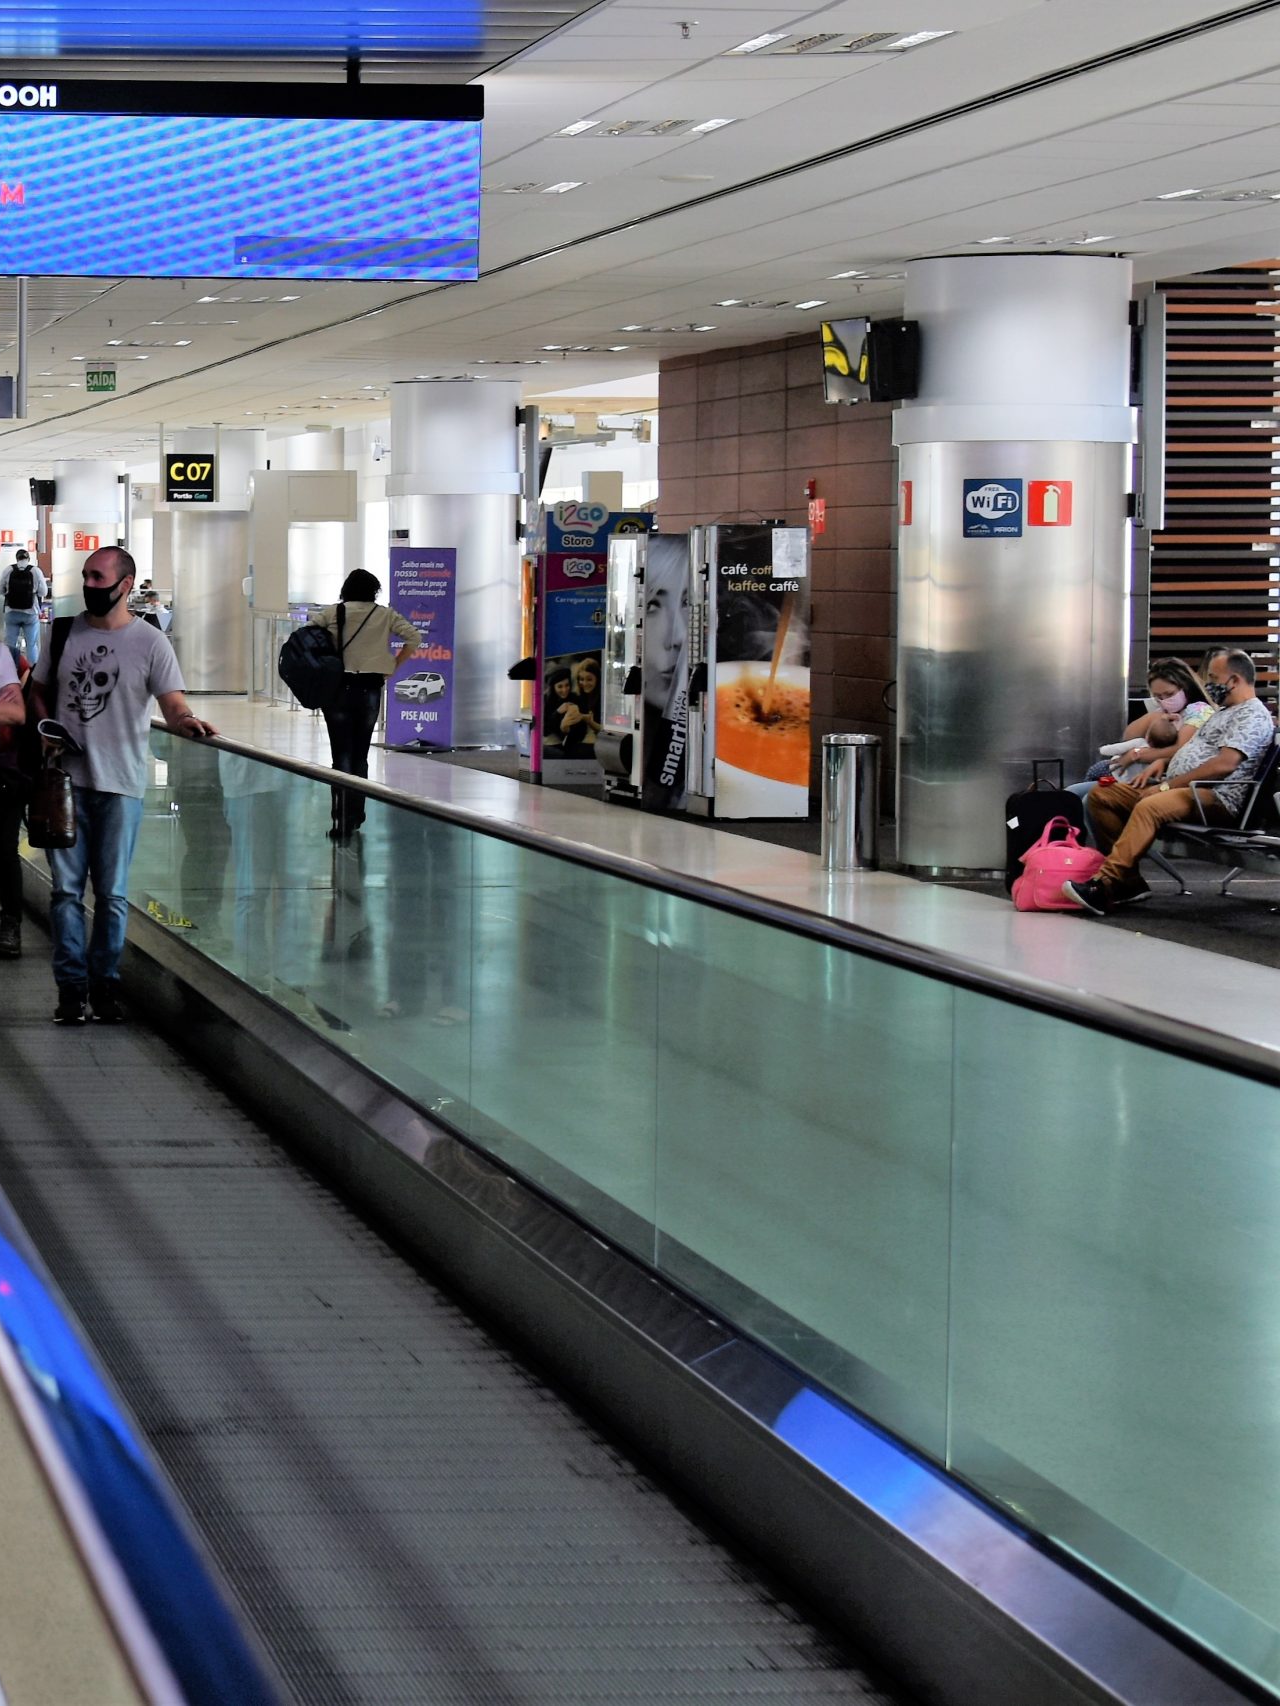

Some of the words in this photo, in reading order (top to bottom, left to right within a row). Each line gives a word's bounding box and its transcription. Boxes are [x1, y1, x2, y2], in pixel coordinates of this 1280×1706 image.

[88, 372, 115, 387] SAÍDA
[170, 462, 184, 481] C
[187, 462, 211, 481] 07
[563, 536, 593, 546] Store
[394, 570, 418, 578] nosso
[721, 563, 748, 575] café
[728, 580, 767, 592] kaffee
[769, 580, 799, 592] caffè
[401, 710, 418, 721] PISE
[418, 711, 438, 722] AQUI
[660, 721, 688, 786] smart
